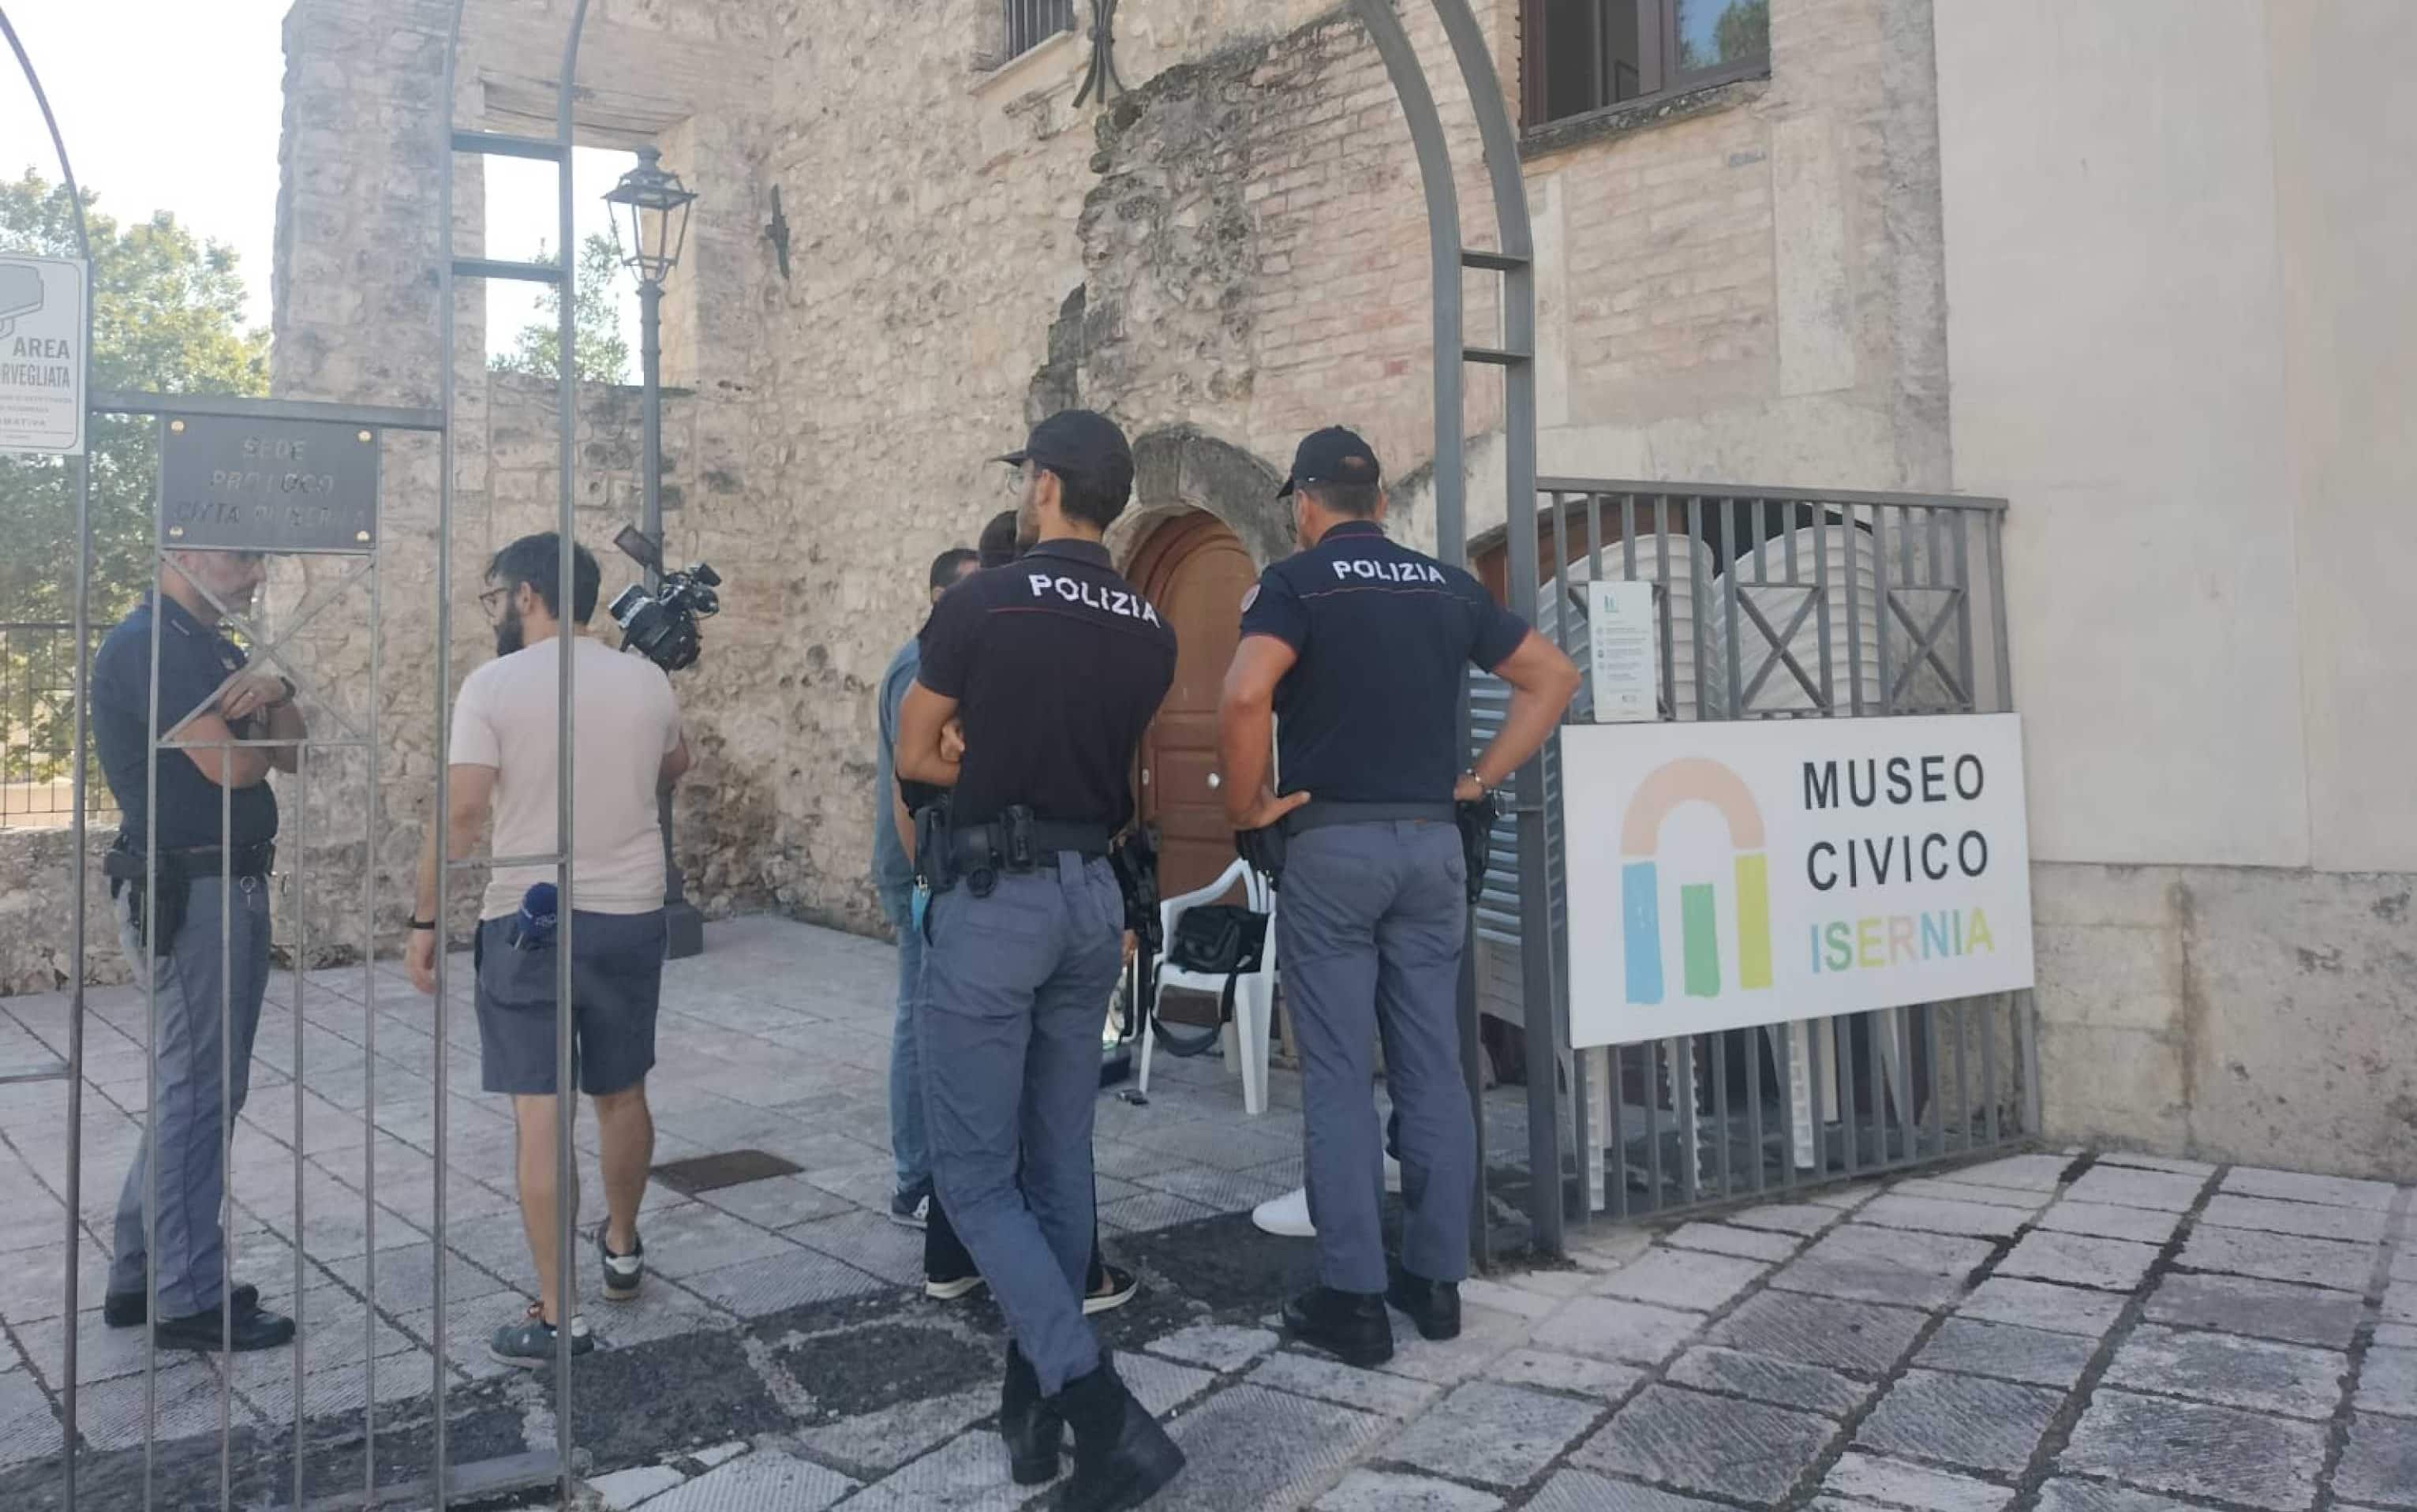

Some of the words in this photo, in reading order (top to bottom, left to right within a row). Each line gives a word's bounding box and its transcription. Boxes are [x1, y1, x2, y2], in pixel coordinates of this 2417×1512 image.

[13, 336, 69, 359] AREA
[0, 363, 69, 387] RVEGLIATA
[241, 436, 306, 460] SEDE
[1332, 560, 1446, 585] POLIZIA
[1029, 574, 1161, 628] POLIZIA
[1803, 754, 1984, 810] MUSEO
[1807, 830, 1988, 891] CIVICO
[1810, 907, 1995, 973] ISERNIA
